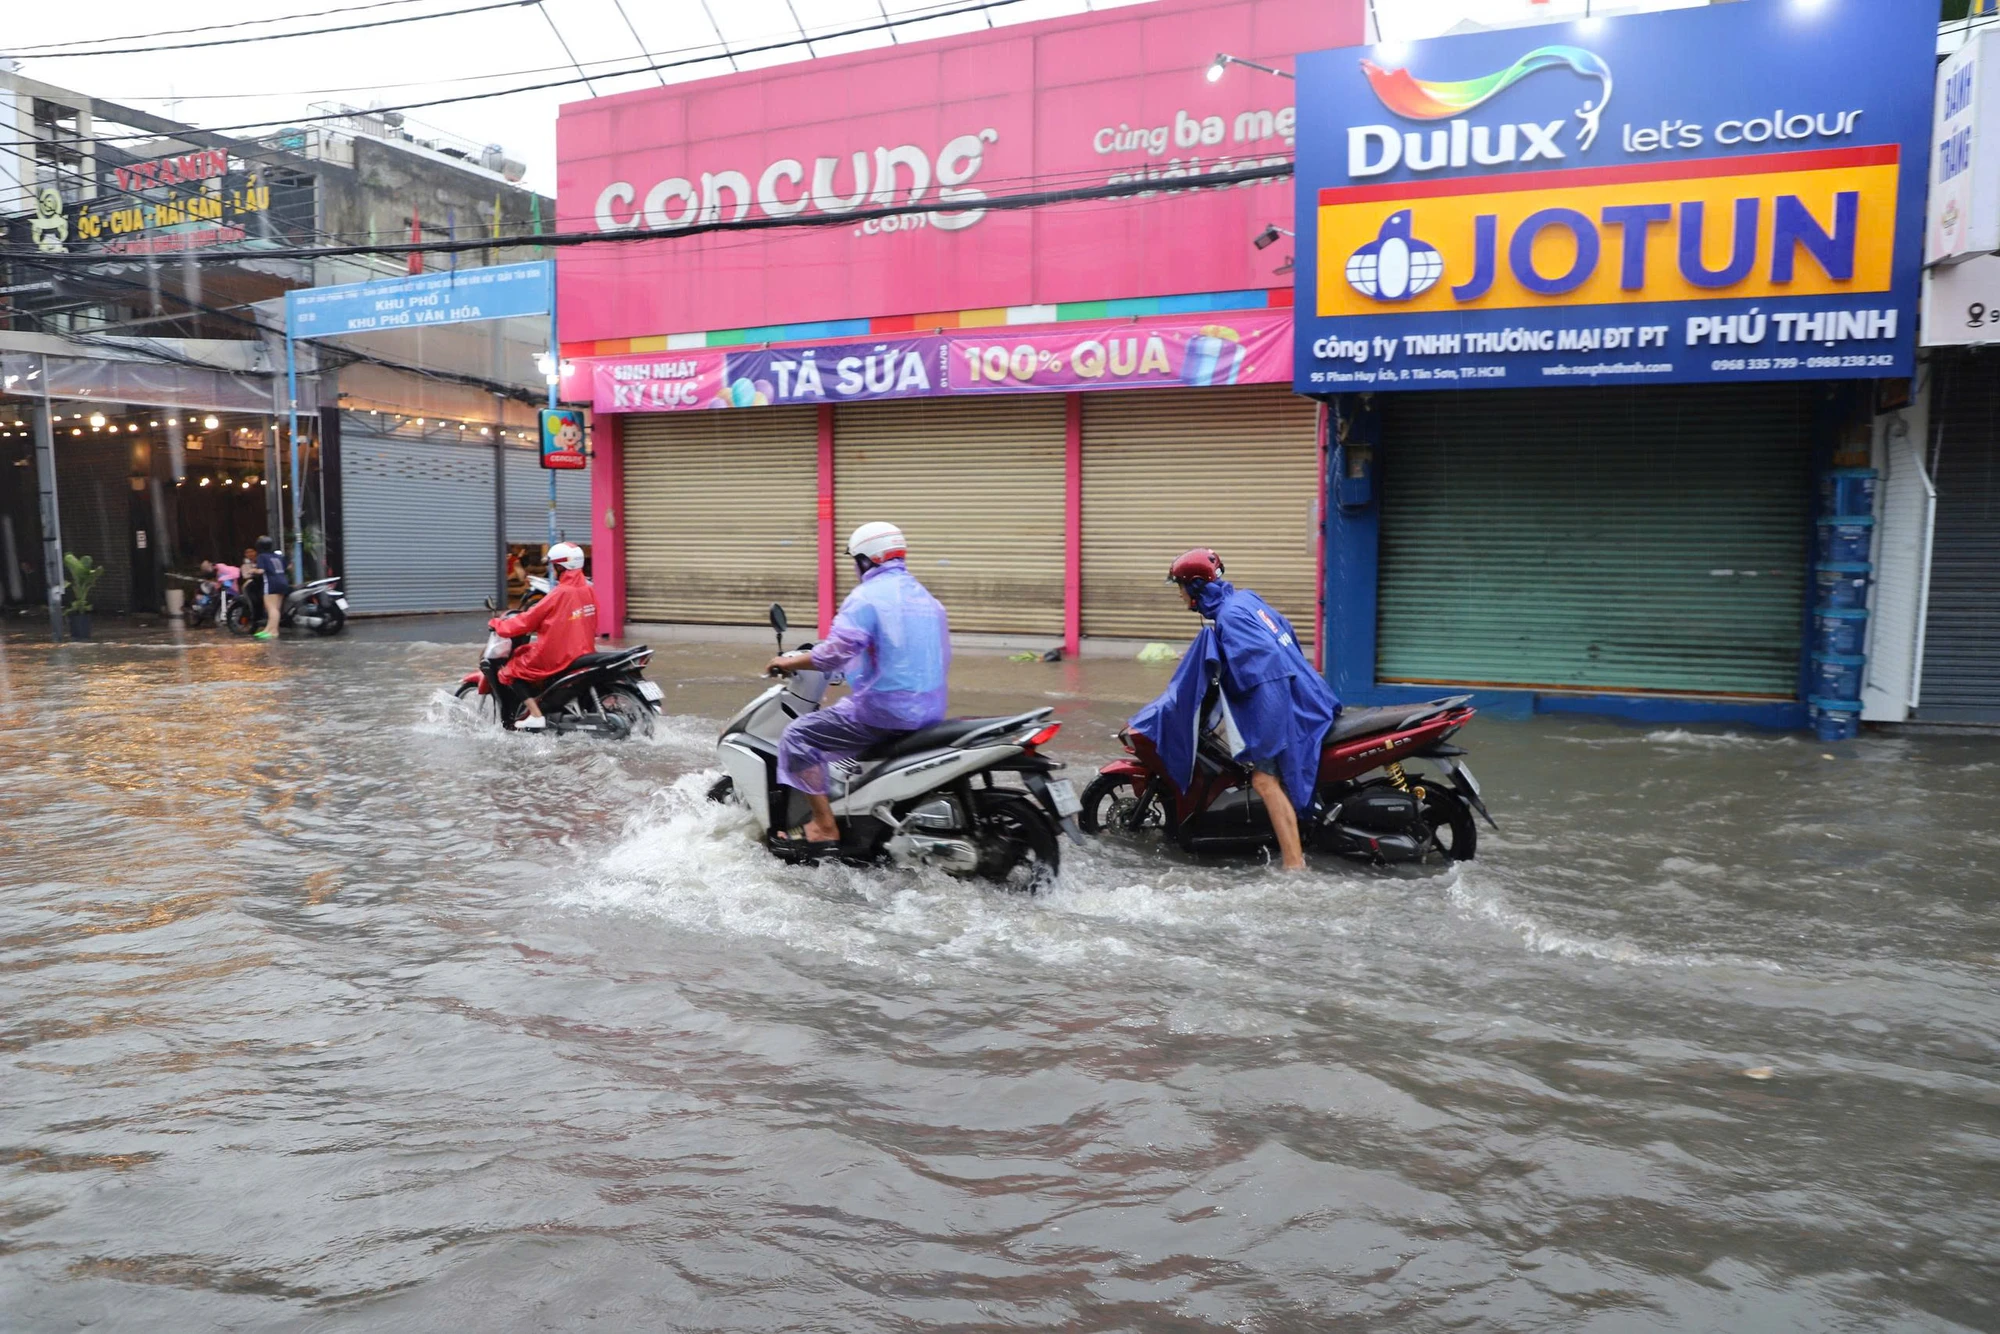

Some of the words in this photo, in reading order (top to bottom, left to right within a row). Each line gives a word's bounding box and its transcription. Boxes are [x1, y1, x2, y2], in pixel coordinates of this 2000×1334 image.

[1093, 123, 1169, 156] Cùng
[1174, 110, 1225, 148] ba
[1233, 106, 1296, 147] mẹ
[1347, 119, 1566, 177] Dulux
[1622, 120, 1703, 152] let's
[1715, 109, 1863, 144] colour
[114, 148, 228, 191] VITAMIN
[111, 208, 144, 233] CUA
[155, 191, 185, 226] HẢI
[187, 187, 222, 222] SẢN
[1451, 191, 1860, 302] JOTUN
[348, 317, 376, 329] KHU
[380, 310, 410, 326] PHỐ
[415, 309, 445, 322] VĂN
[450, 305, 481, 319] HÓA
[375, 299, 404, 311] KHU
[409, 290, 438, 307] PHỐ
[1313, 335, 1369, 363] Công
[1373, 335, 1398, 362] ty
[1403, 333, 1461, 355] TNHH
[1464, 327, 1554, 354] THƯƠNG
[1557, 328, 1601, 352] MẠI
[1602, 326, 1635, 348] ĐT
[1638, 325, 1669, 347] PT
[1686, 307, 1767, 345] PHÚ
[1771, 309, 1898, 347] THỊNH
[615, 364, 651, 380] SINH
[653, 359, 697, 379] NHẬT
[770, 350, 825, 398] TÃ
[835, 345, 930, 395] SỮA
[965, 345, 1063, 382] 100%
[1071, 331, 1171, 378] QUÀ
[1326, 371, 1353, 381] Phan
[1354, 372, 1376, 383] Huy
[1747, 358, 1771, 370] 335
[1773, 357, 1799, 369] 799
[651, 382, 698, 409] LỤC
